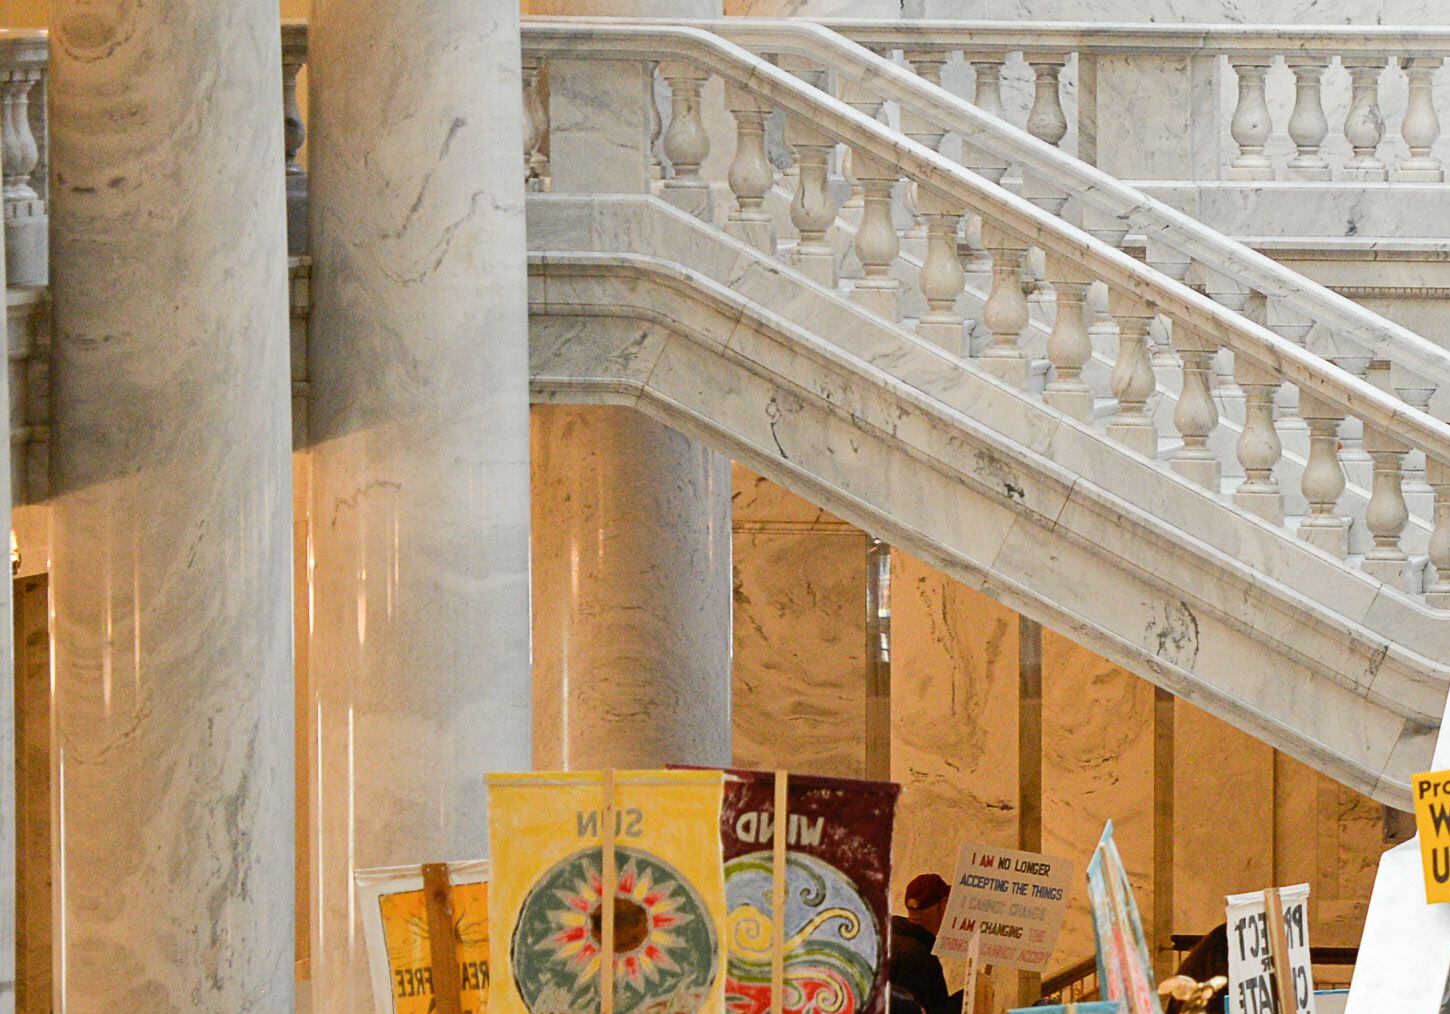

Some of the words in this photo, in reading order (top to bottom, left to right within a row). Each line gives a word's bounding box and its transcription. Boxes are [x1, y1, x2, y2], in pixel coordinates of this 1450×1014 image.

[971, 852, 977, 866] I
[979, 854, 995, 868] AM
[997, 856, 1011, 871] NO
[1014, 859, 1051, 877] LONGER
[960, 873, 1009, 893] ACCEPTING
[1011, 881, 1029, 897] THE
[1031, 884, 1064, 901] THINGS
[951, 916, 958, 930] I
[960, 917, 976, 932] AM
[979, 920, 1023, 939] CHANGING
